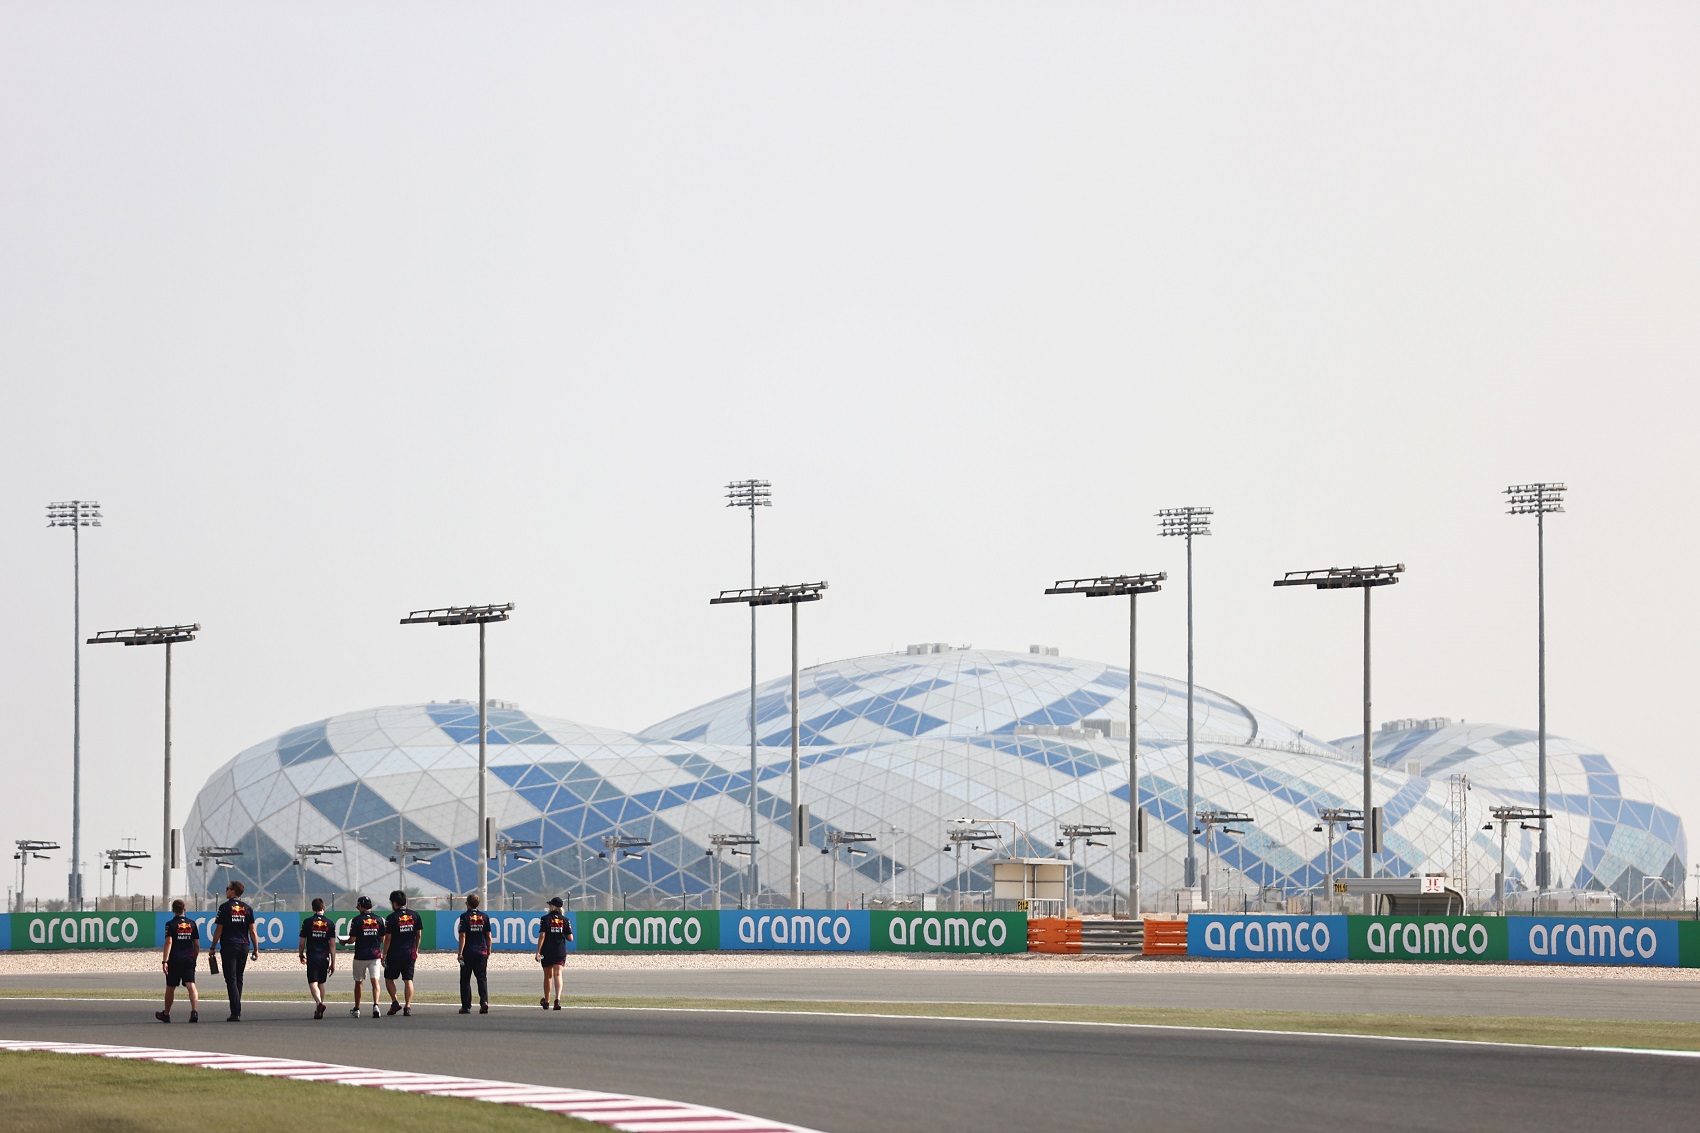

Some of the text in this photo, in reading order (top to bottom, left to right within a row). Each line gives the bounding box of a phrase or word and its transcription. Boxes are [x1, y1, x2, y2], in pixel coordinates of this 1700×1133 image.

[29, 917, 138, 943] aramco
[592, 917, 702, 945] aramco
[738, 915, 851, 945] aramco
[889, 916, 1007, 947] aramco
[1204, 921, 1330, 952] aramco
[1367, 922, 1488, 954] aramco
[1529, 924, 1657, 959] aramco
